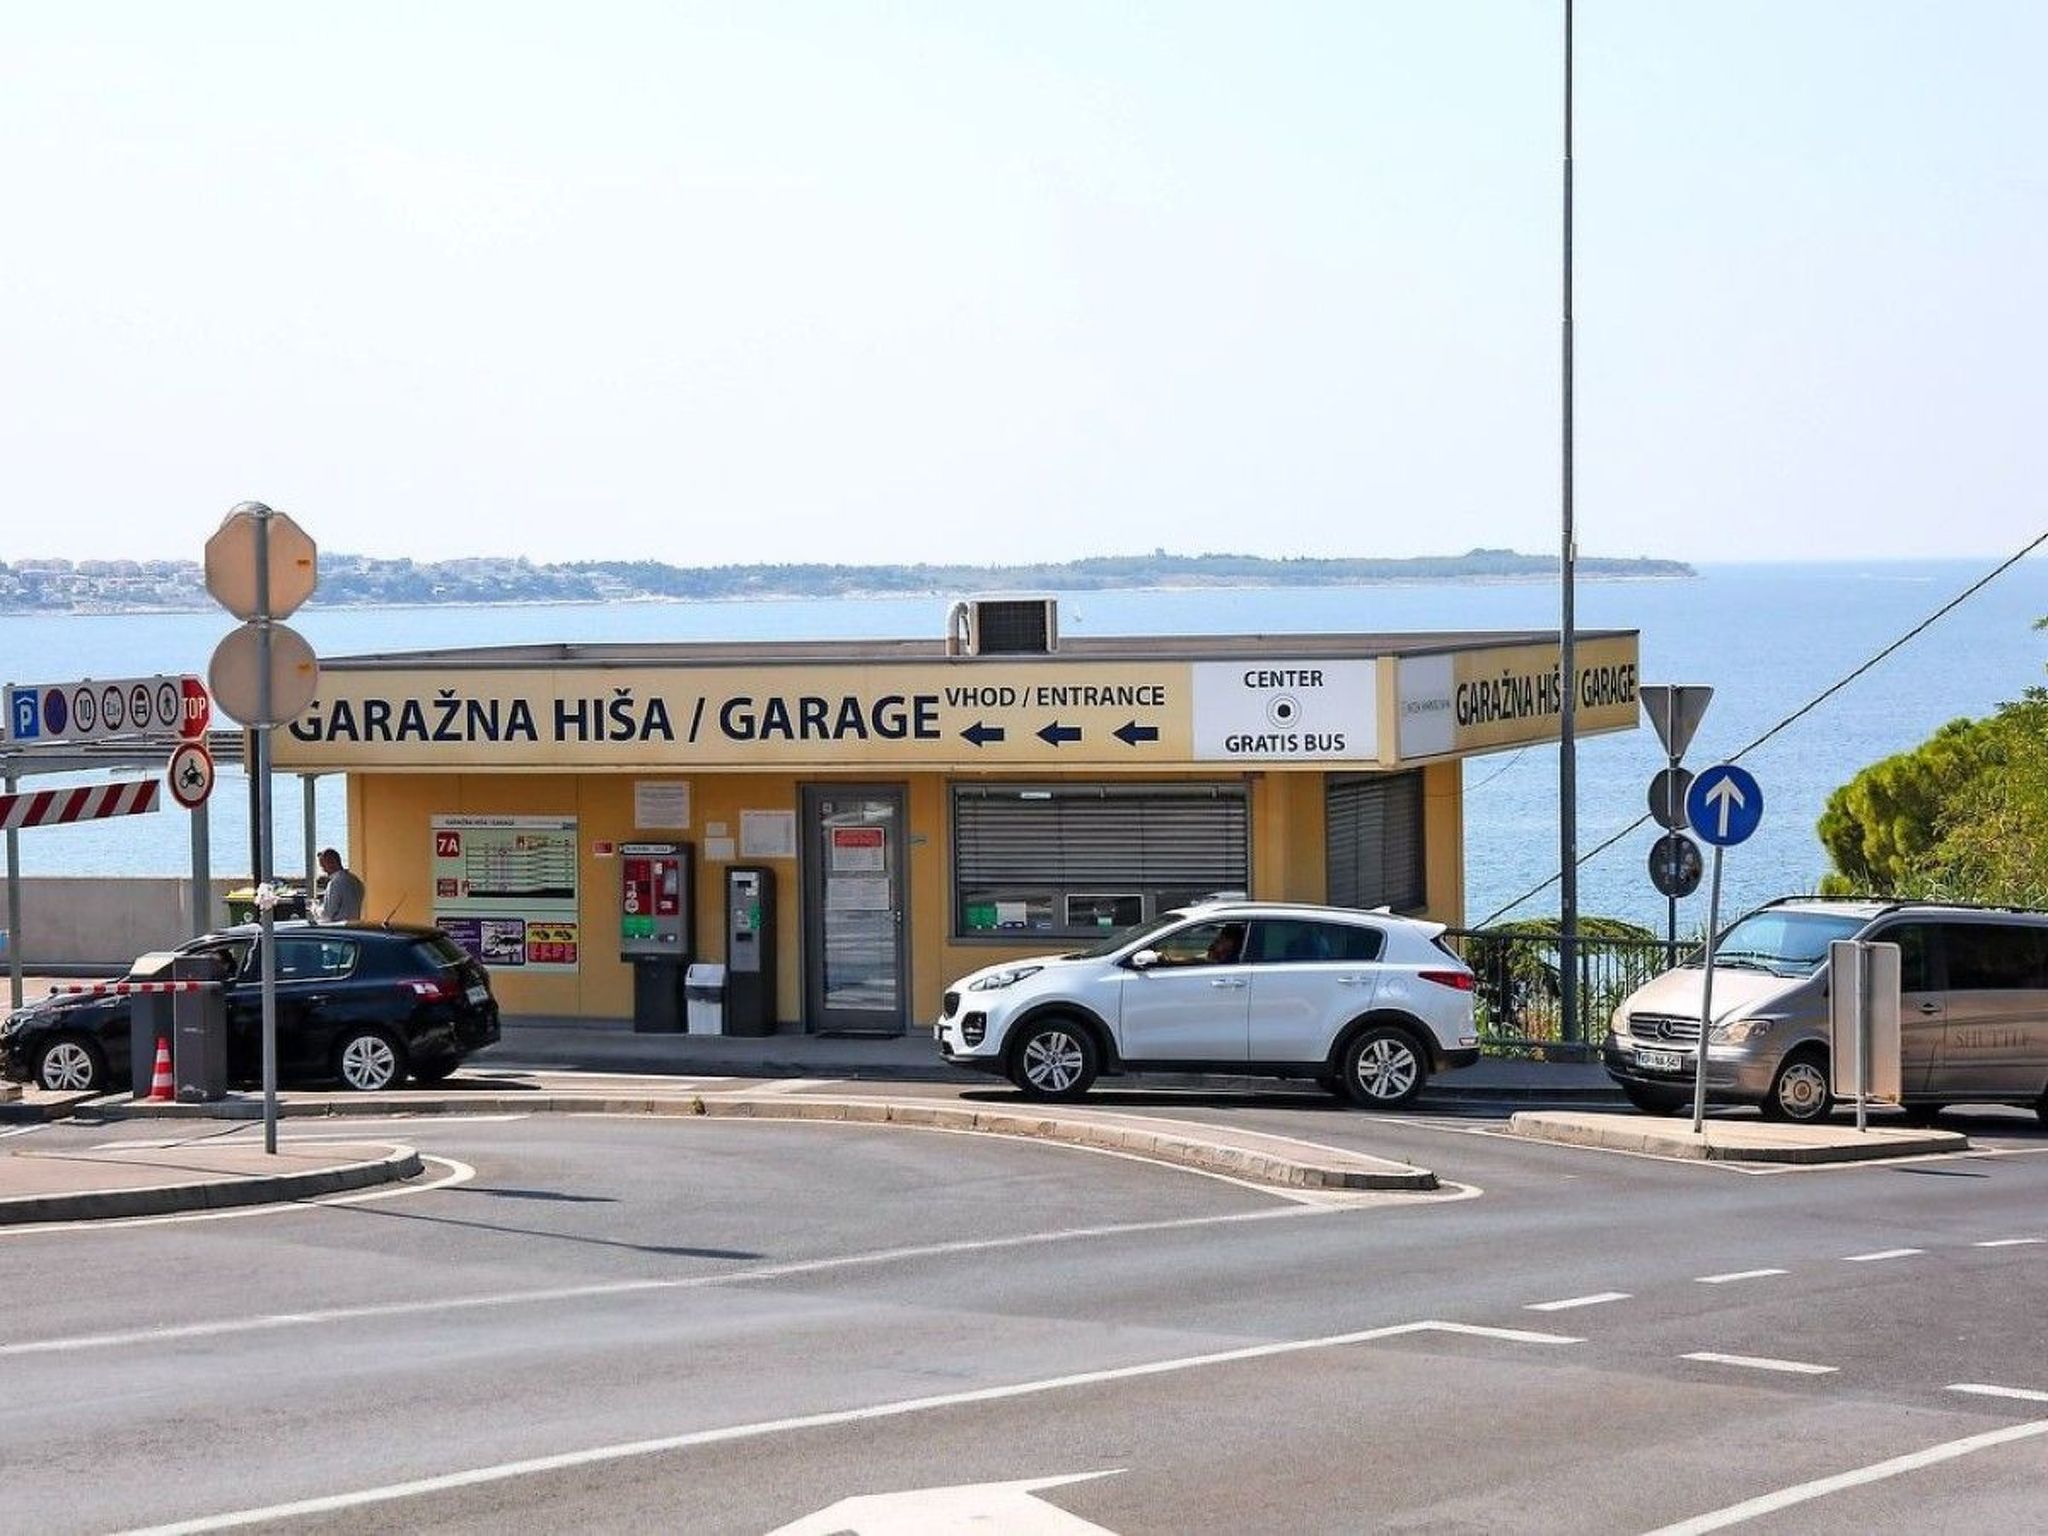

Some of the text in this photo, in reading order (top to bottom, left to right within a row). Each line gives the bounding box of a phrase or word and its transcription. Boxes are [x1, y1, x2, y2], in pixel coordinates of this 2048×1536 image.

[1244, 670, 1323, 688] CENTER
[945, 686, 1165, 708] VHOD / ENTRANCE
[1456, 668, 1534, 726] GARAŽNA
[1537, 664, 1562, 715] HIŠ
[1581, 664, 1635, 707] GARAGE
[182, 697, 206, 719] TOP
[288, 688, 941, 743] GARAŽNA HIŠA / GARAGE
[1225, 734, 1346, 753] GRATIS BUS
[438, 838, 458, 853] 7A
